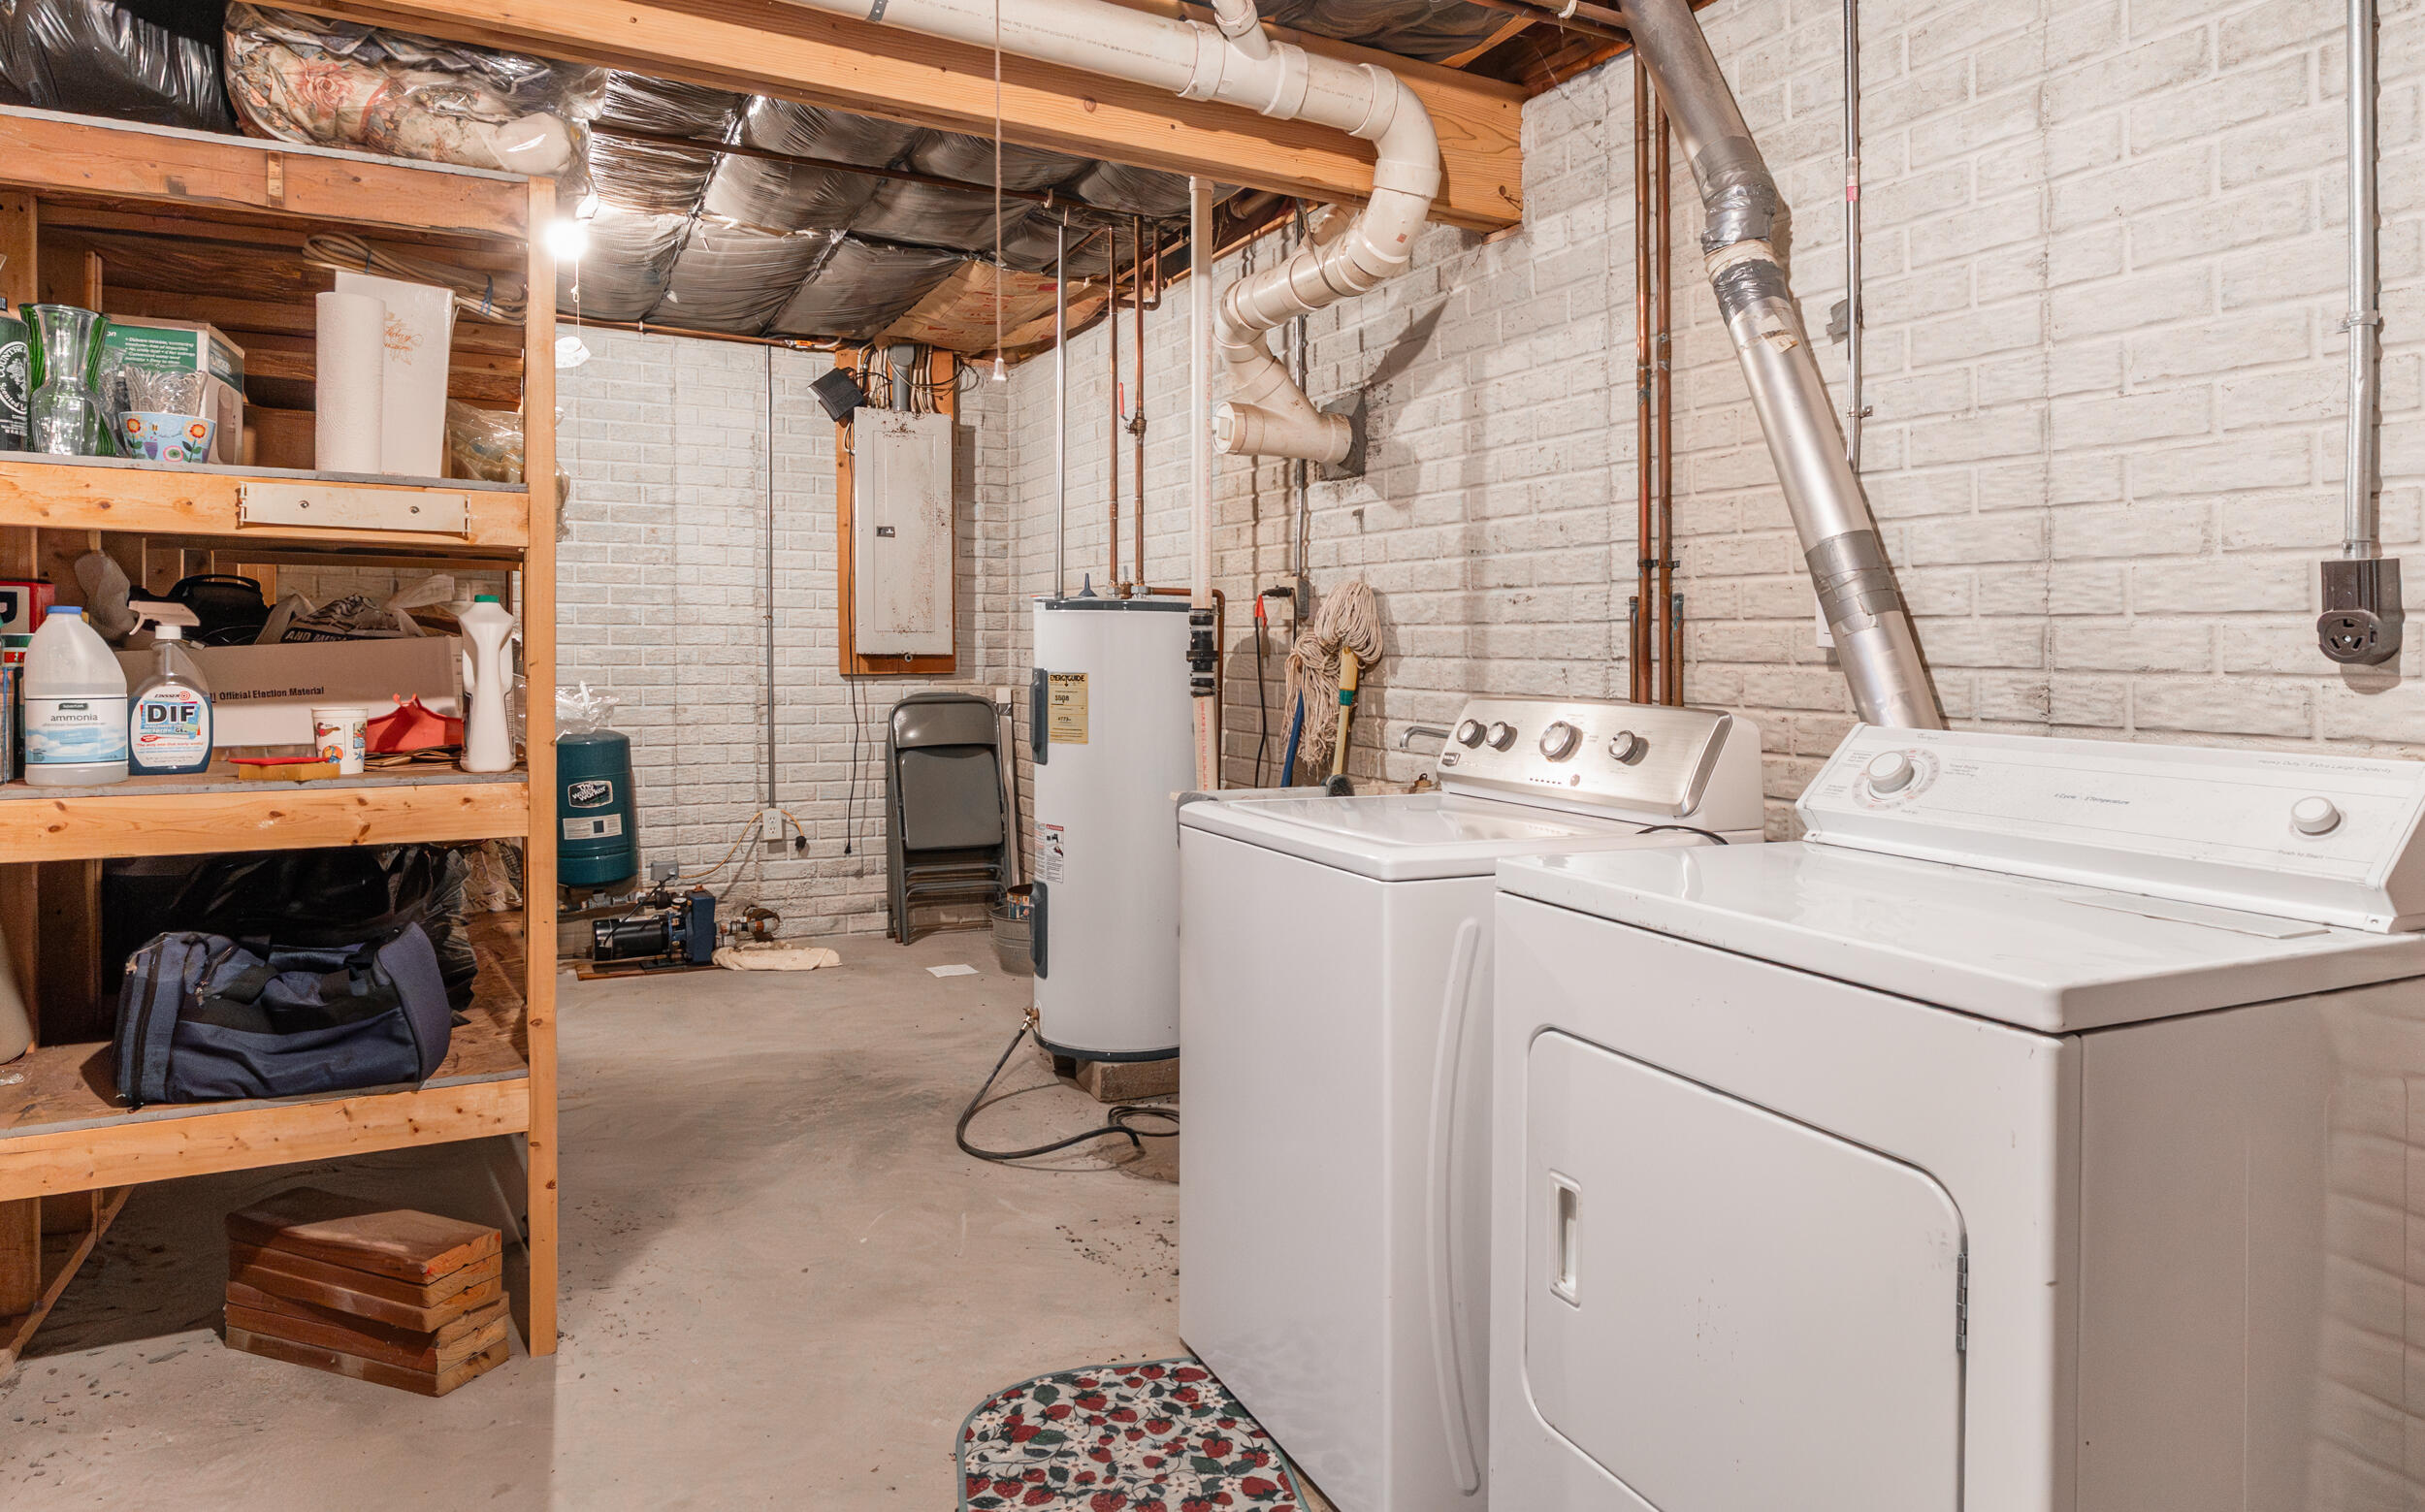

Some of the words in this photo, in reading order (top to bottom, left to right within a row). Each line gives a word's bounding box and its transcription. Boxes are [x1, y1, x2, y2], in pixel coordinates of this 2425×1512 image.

[285, 630, 310, 641] AND
[219, 690, 251, 700] Official
[252, 689, 287, 698] Election
[289, 687, 324, 696] Material
[147, 704, 195, 723] DIF
